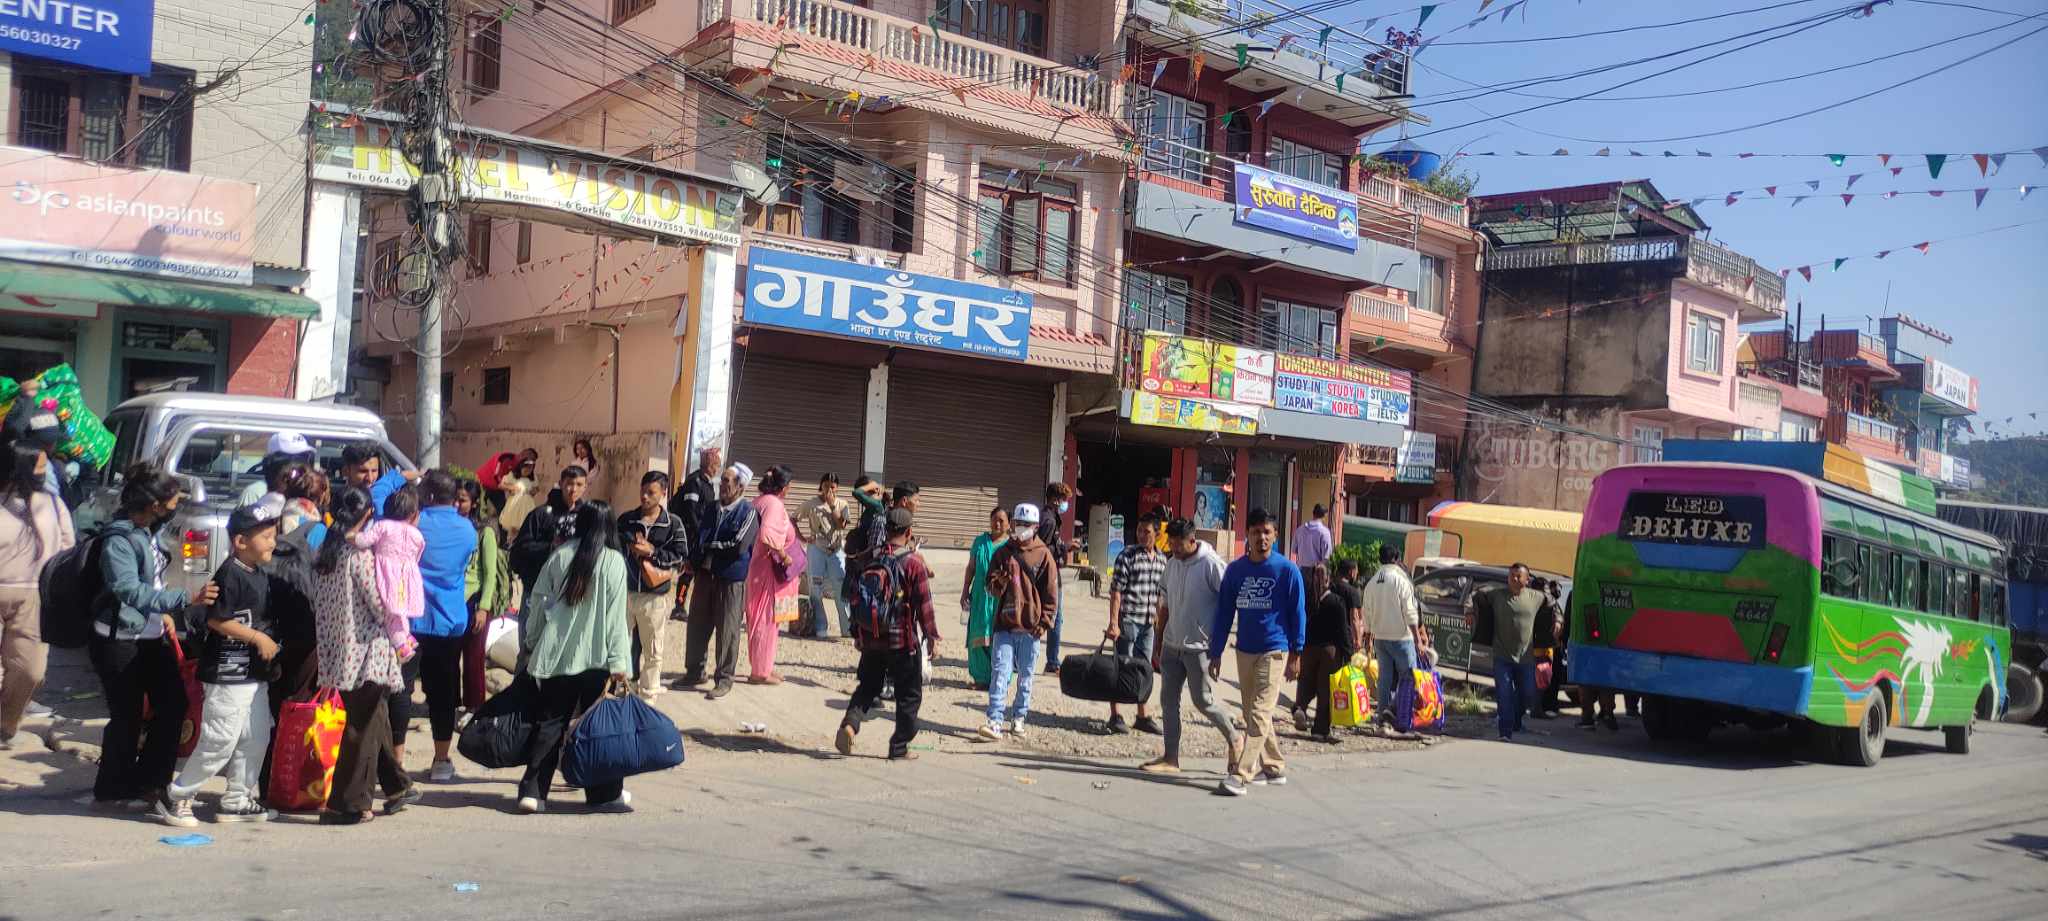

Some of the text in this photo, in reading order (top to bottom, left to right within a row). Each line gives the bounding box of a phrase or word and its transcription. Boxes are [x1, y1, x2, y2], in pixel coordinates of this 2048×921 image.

[346, 171, 365, 182] Tel:
[353, 121, 717, 230] HTEL VISION
[753, 264, 1030, 347] गाउँघर
[1278, 354, 1390, 386] TOMODACHI INSTITUTE
[1277, 375, 1321, 393] STUDY IN
[1327, 382, 1365, 400] STUDY IN
[1944, 383, 1967, 403] JAPAN
[1284, 395, 1313, 411] JAPAN
[1370, 389, 1397, 404] STUDY
[1331, 400, 1359, 417] KOREA
[1376, 406, 1399, 421] IELTS
[1665, 496, 1724, 515] LED
[1630, 515, 1752, 542] DELUXE
